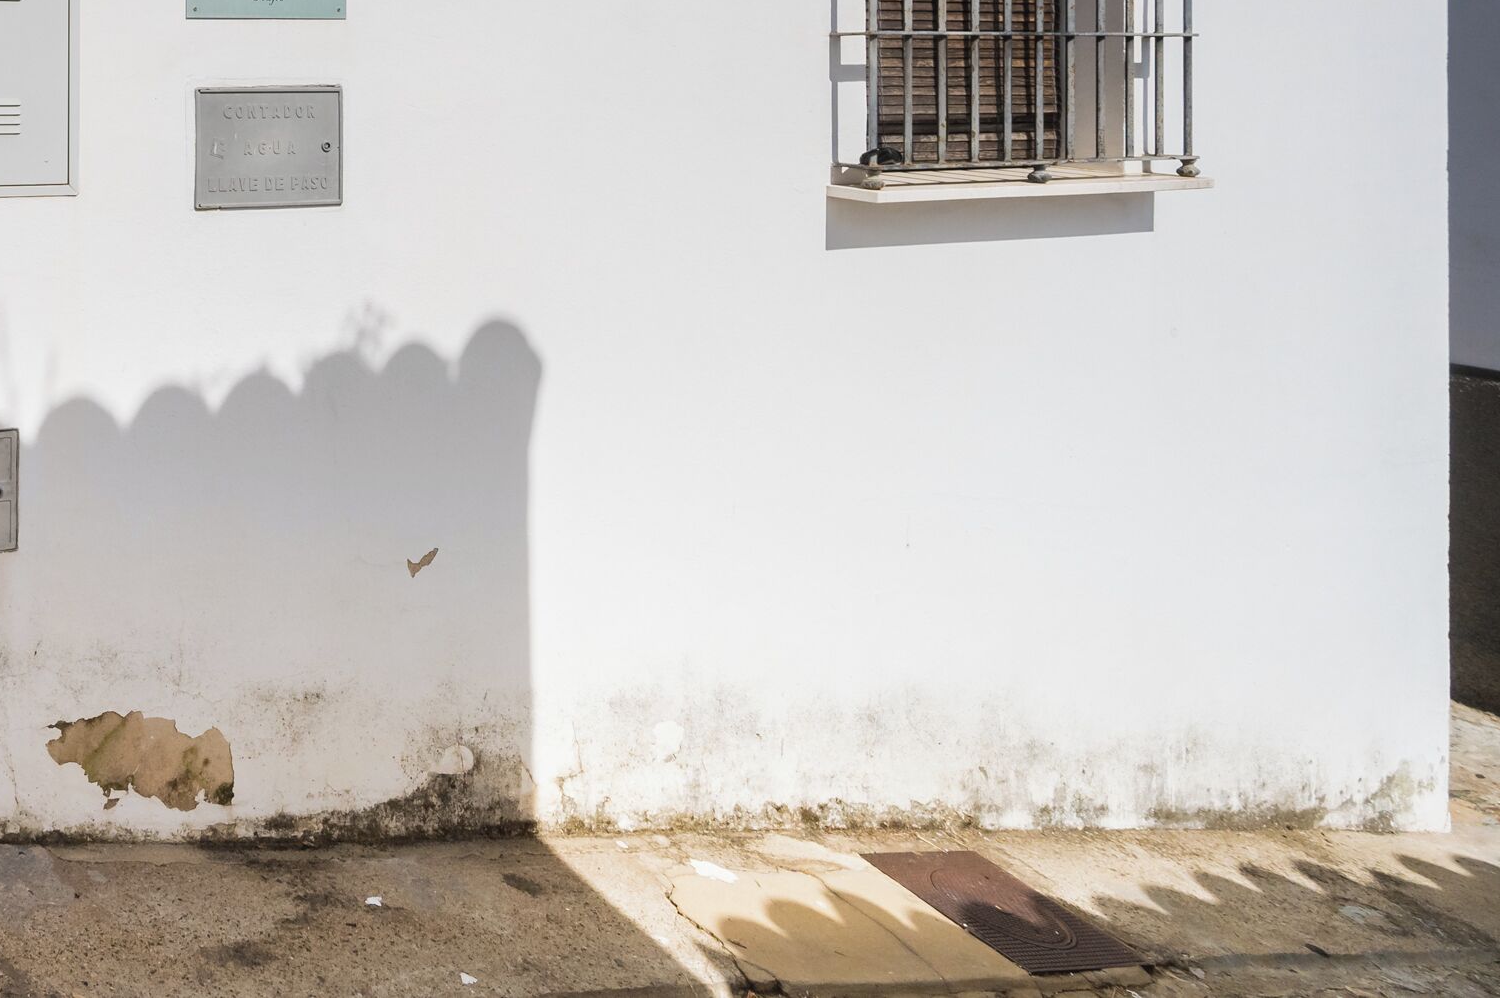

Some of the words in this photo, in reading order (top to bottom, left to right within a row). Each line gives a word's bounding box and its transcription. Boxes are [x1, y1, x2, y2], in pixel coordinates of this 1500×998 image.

[222, 104, 316, 120] CONTADOR
[243, 138, 297, 156] AGUA
[207, 177, 259, 193] LLAVE
[264, 176, 285, 192] DE
[290, 176, 329, 191] PASO
